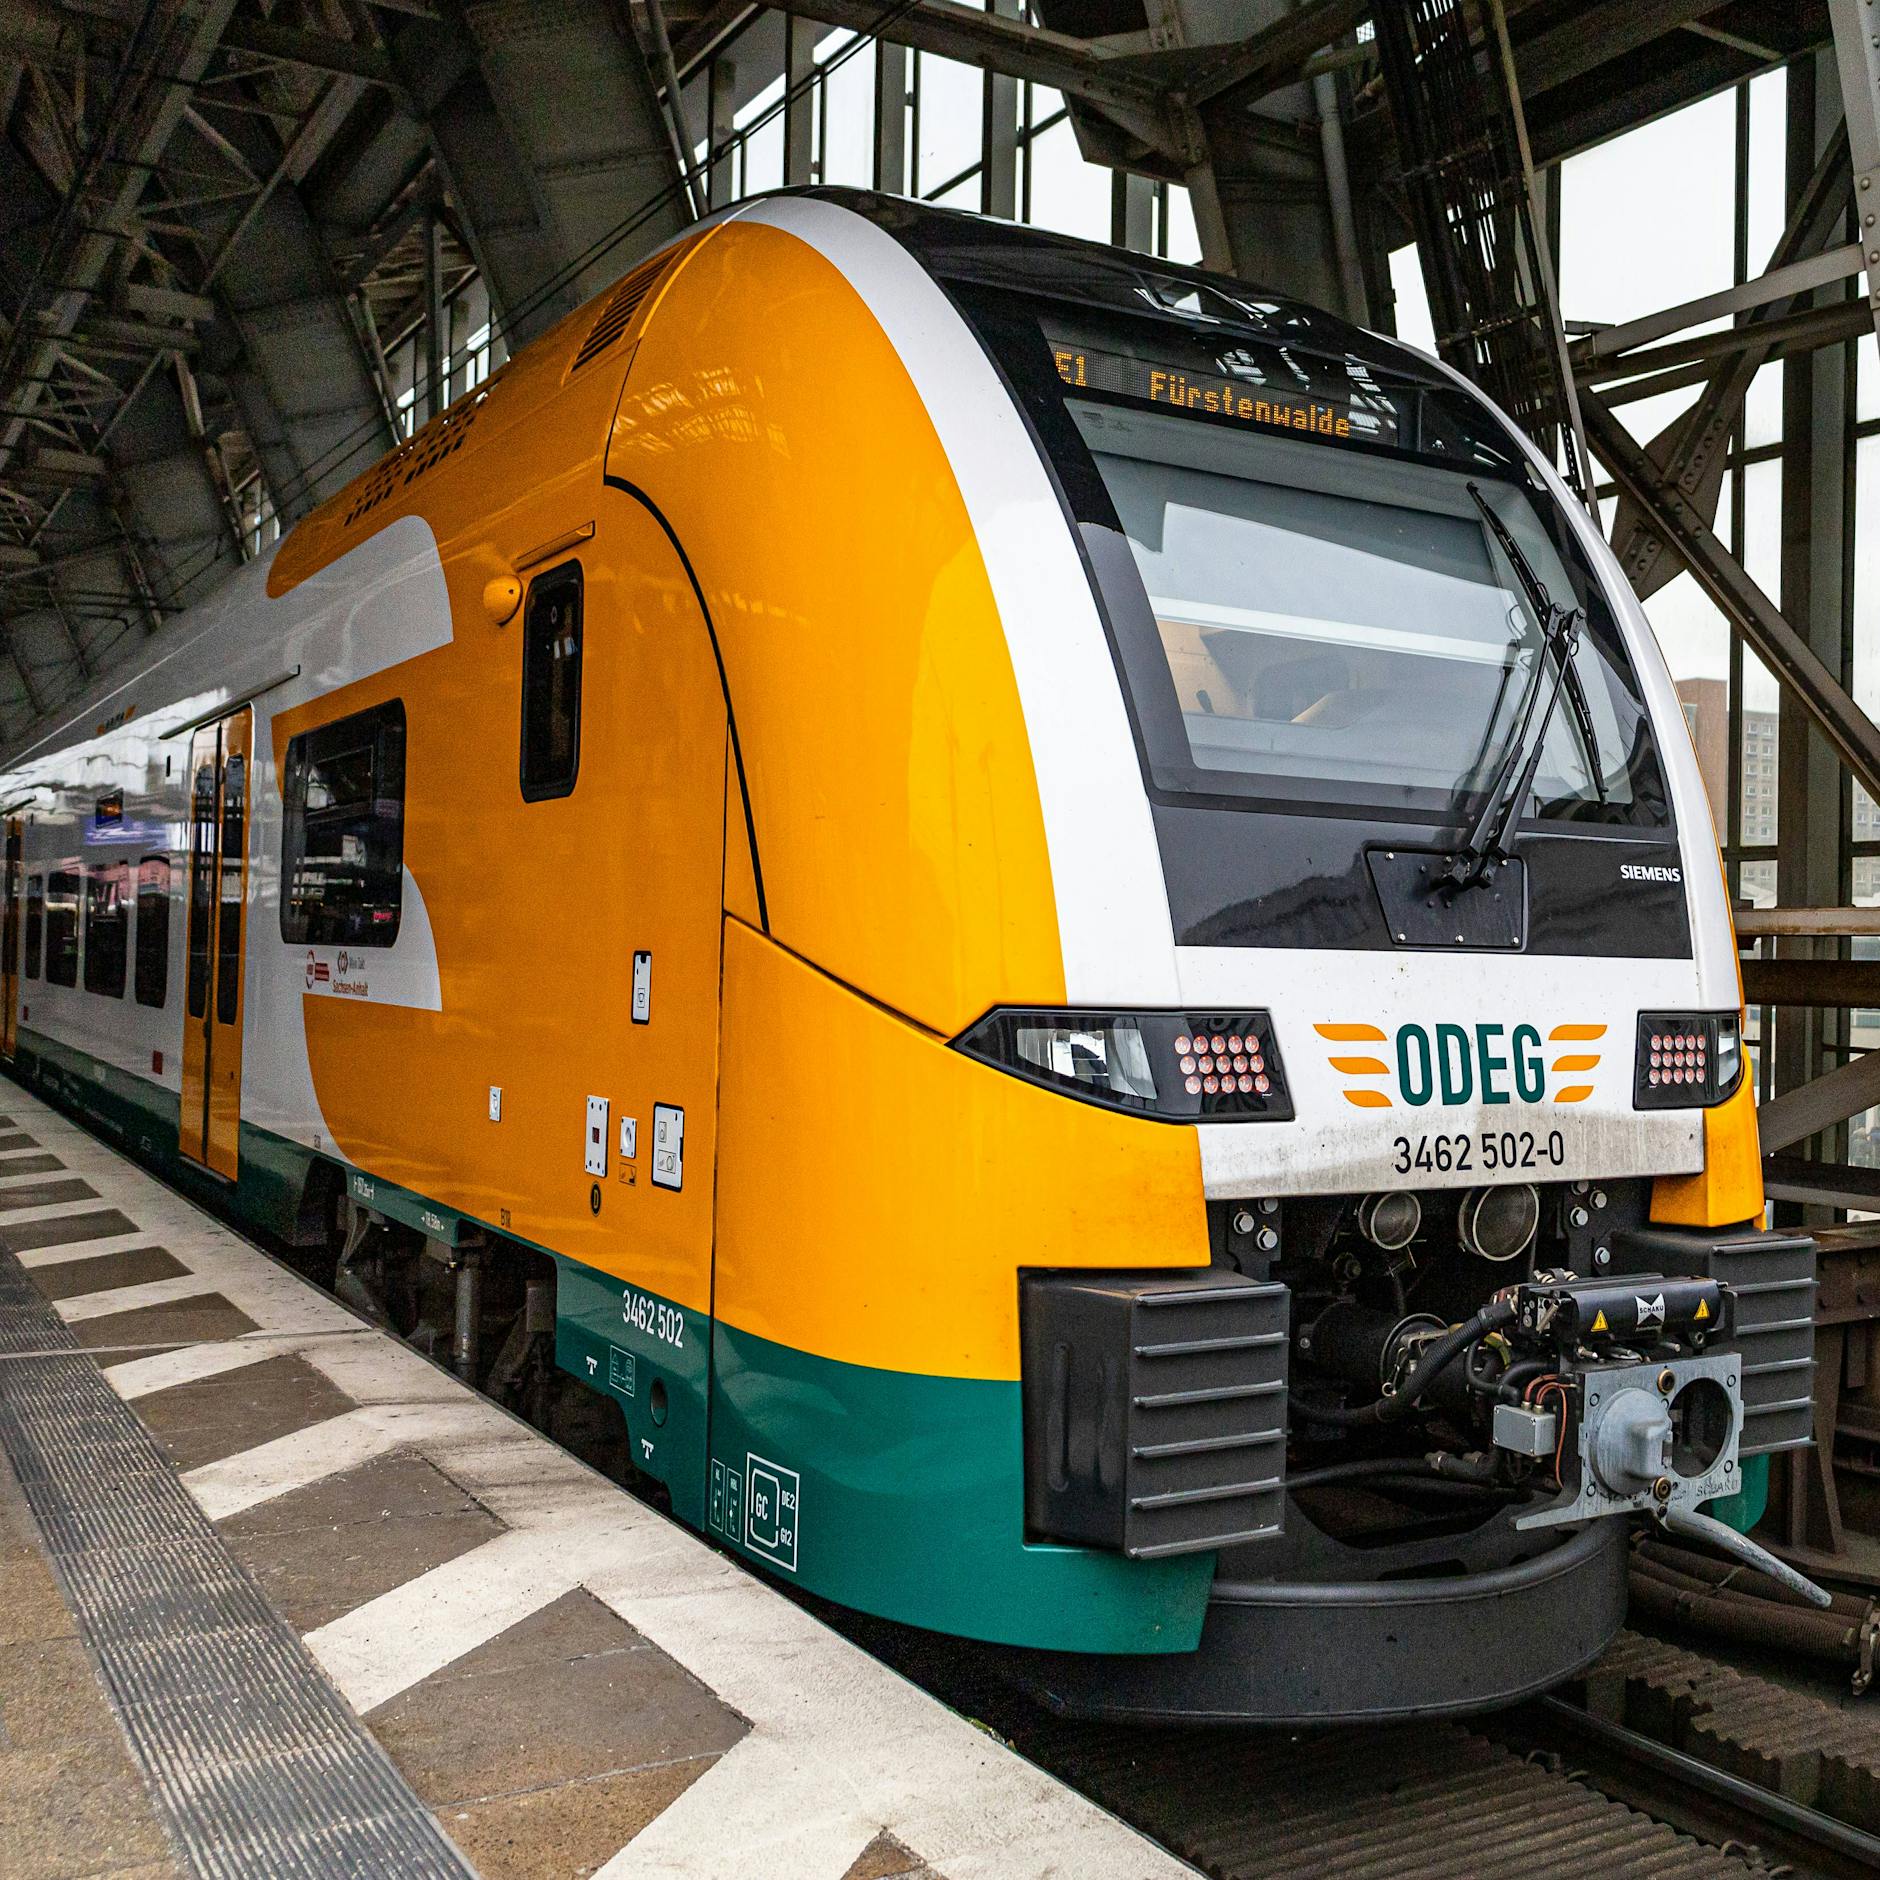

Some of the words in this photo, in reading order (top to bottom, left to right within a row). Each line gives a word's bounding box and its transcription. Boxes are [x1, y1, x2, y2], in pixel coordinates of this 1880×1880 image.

[1150, 370, 1350, 438] Fürstenwalde
[1620, 865, 1682, 883] SIEMENS
[1396, 1023, 1546, 1107] ODEG
[1393, 1135, 1472, 1174] 3462
[1481, 1130, 1565, 1168] 502-0
[622, 1289, 655, 1335] 3462
[657, 1303, 684, 1349] 502
[755, 1492, 769, 1521] GC
[781, 1489, 796, 1511] DE2
